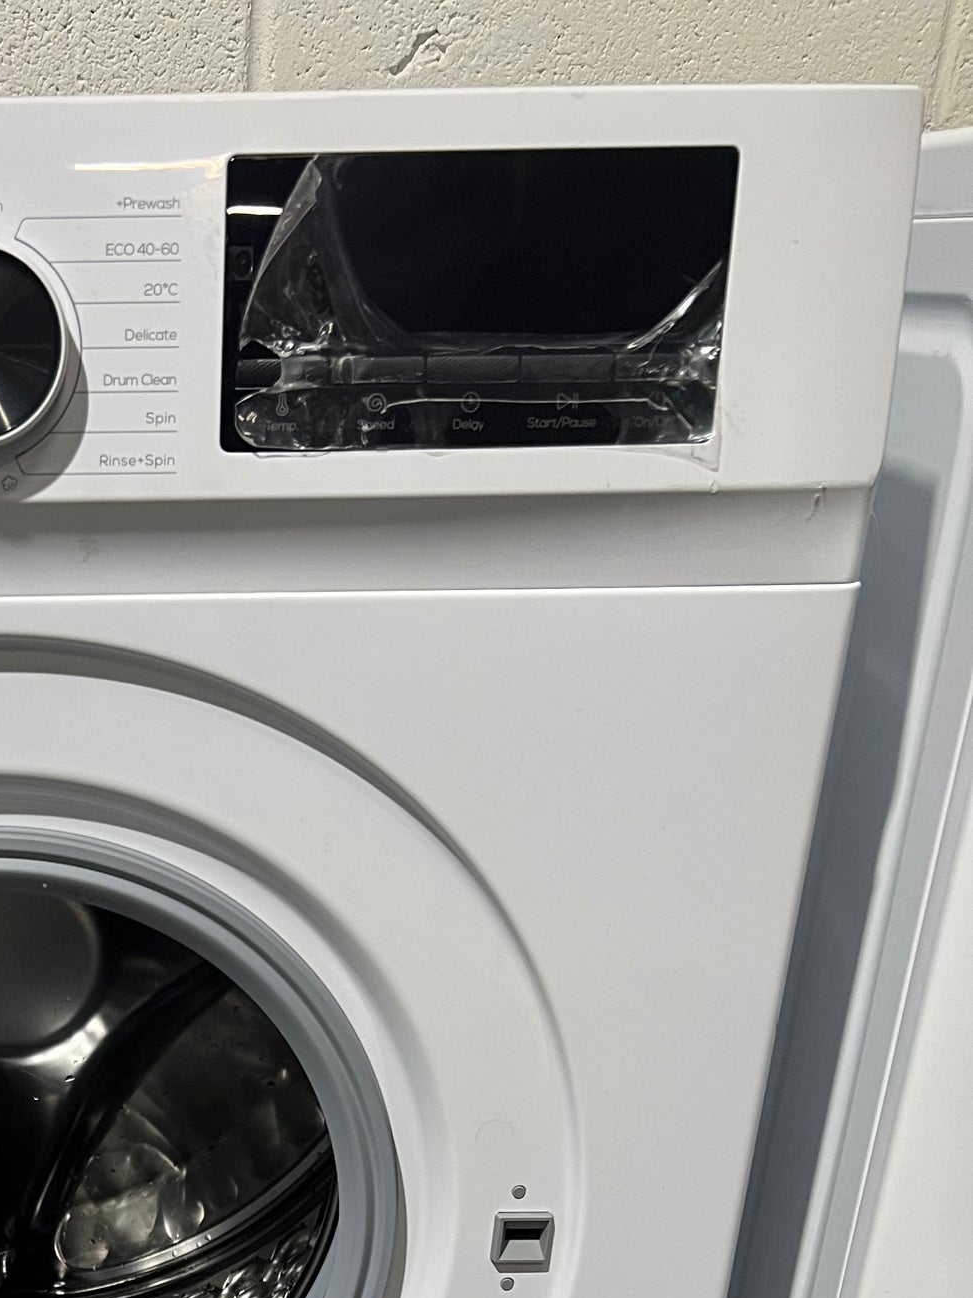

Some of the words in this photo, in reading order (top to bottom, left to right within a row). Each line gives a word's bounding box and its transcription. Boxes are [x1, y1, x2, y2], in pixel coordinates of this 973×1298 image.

[116, 196, 180, 210] +Prewash
[105, 243, 135, 256] ECO
[136, 242, 179, 256] 40-60
[143, 282, 179, 297] 20°C
[124, 328, 178, 342] Delicate
[103, 373, 139, 387] Drum
[141, 372, 178, 387] Clean
[145, 411, 176, 427] Spin
[452, 418, 485, 433] Delay
[526, 415, 597, 430] Start/Pause
[99, 453, 176, 469] Rinse+Spin
